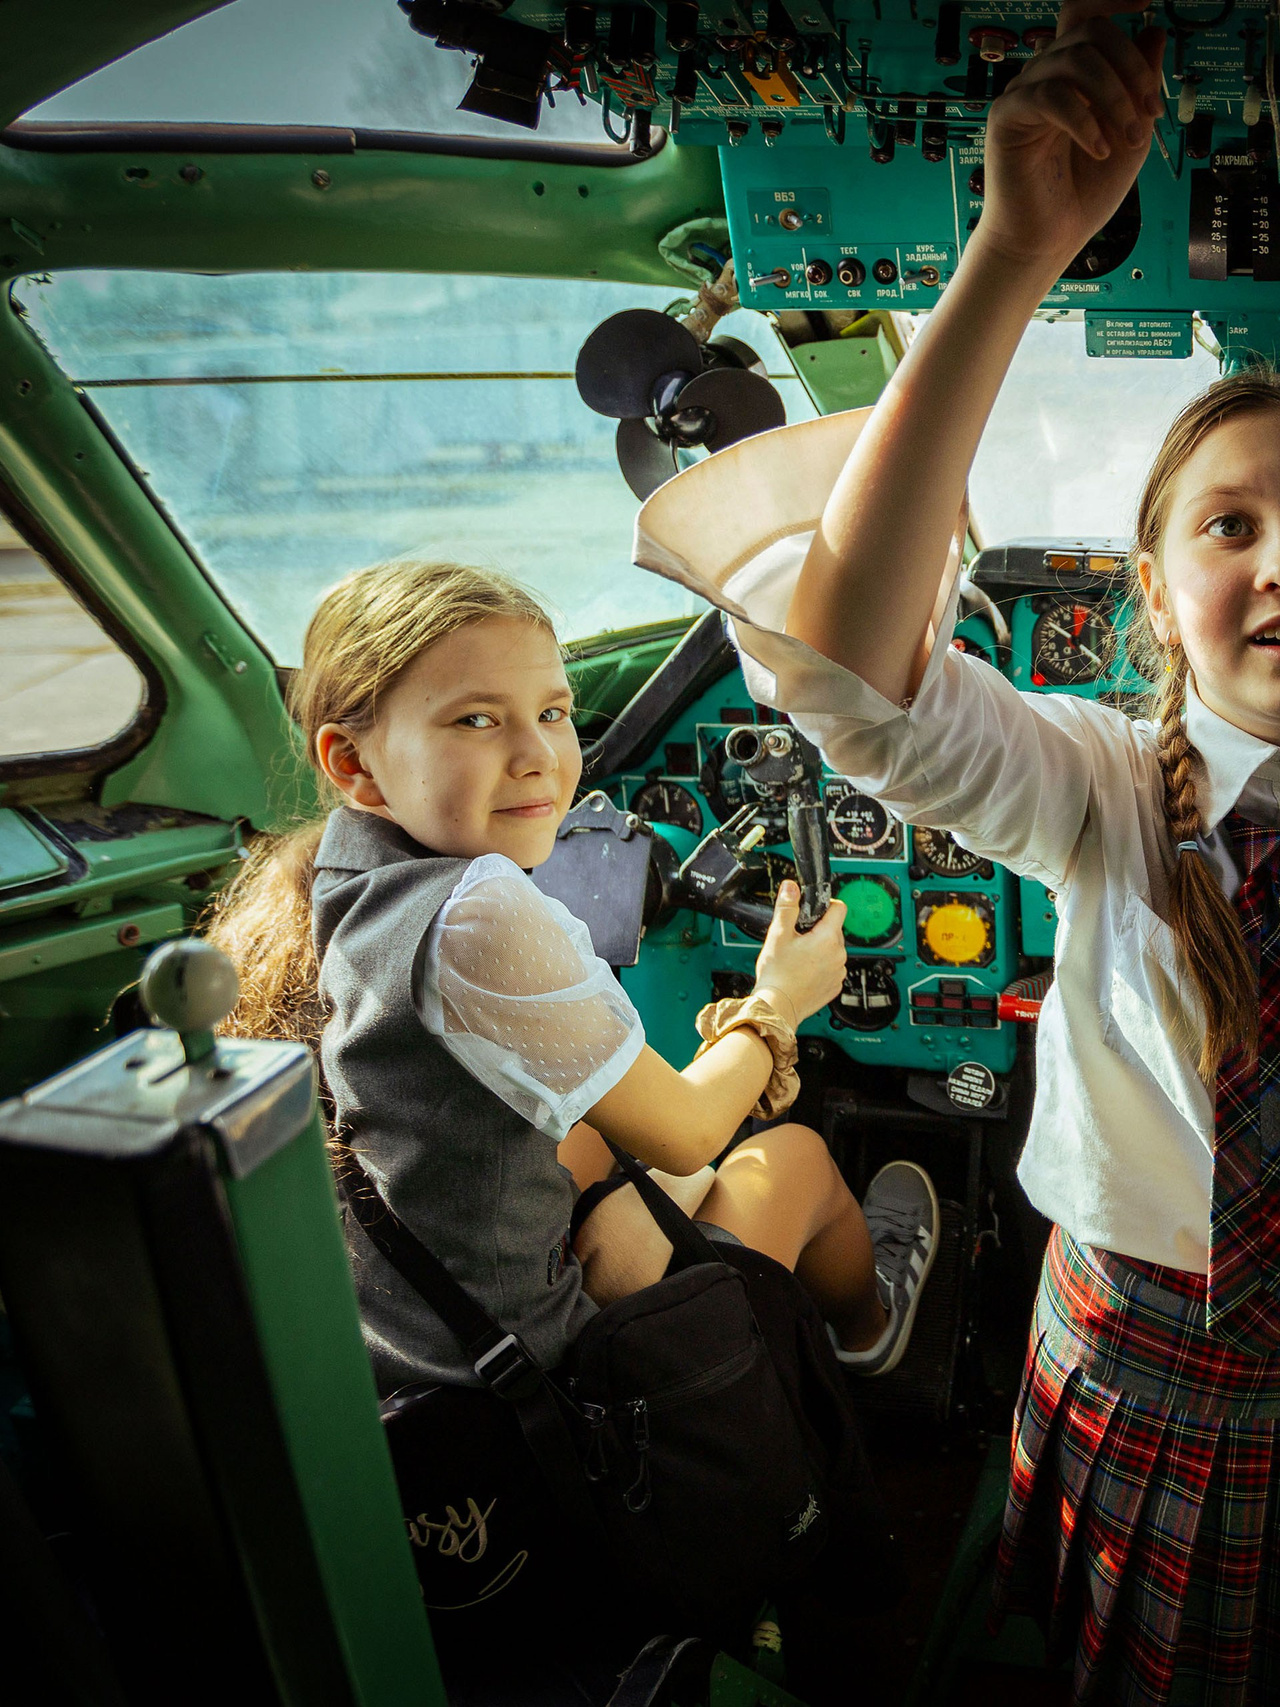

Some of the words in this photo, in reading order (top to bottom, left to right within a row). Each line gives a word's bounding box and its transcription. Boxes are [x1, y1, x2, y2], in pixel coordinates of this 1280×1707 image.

[958, 157, 985, 165] ЗАКРЫ
[1214, 195, 1223, 204] 10
[1260, 196, 1269, 205] 10
[1214, 207, 1222, 216] 15
[1259, 208, 1269, 217] 15
[816, 213, 823, 224] 2
[1211, 219, 1222, 229] 20
[1259, 221, 1270, 230] 20
[1211, 232, 1221, 241] 25
[1258, 233, 1270, 242] 25
[839, 246, 859, 255] ТЕСТ
[915, 244, 936, 253] КУРС
[1211, 244, 1221, 254] 30
[1258, 246, 1270, 255] 30
[905, 252, 948, 262] ЗАДАННЫЙ
[790, 263, 805, 272] VOR
[746, 261, 758, 294] ВЫЛ
[1060, 283, 1101, 293] ЗАКРЫЛКИ
[784, 290, 809, 299] МЯГКО
[846, 289, 862, 298] СВК
[1096, 330, 1105, 338] НЕ
[1106, 329, 1137, 338] ОСТАВЛЯЙ
[1150, 331, 1182, 339] ВНИМАНИЯ
[1153, 339, 1173, 347] АБСУ
[1014, 1009, 1039, 1019] ТЯНУТ
[403, 1497, 498, 1564] asy
